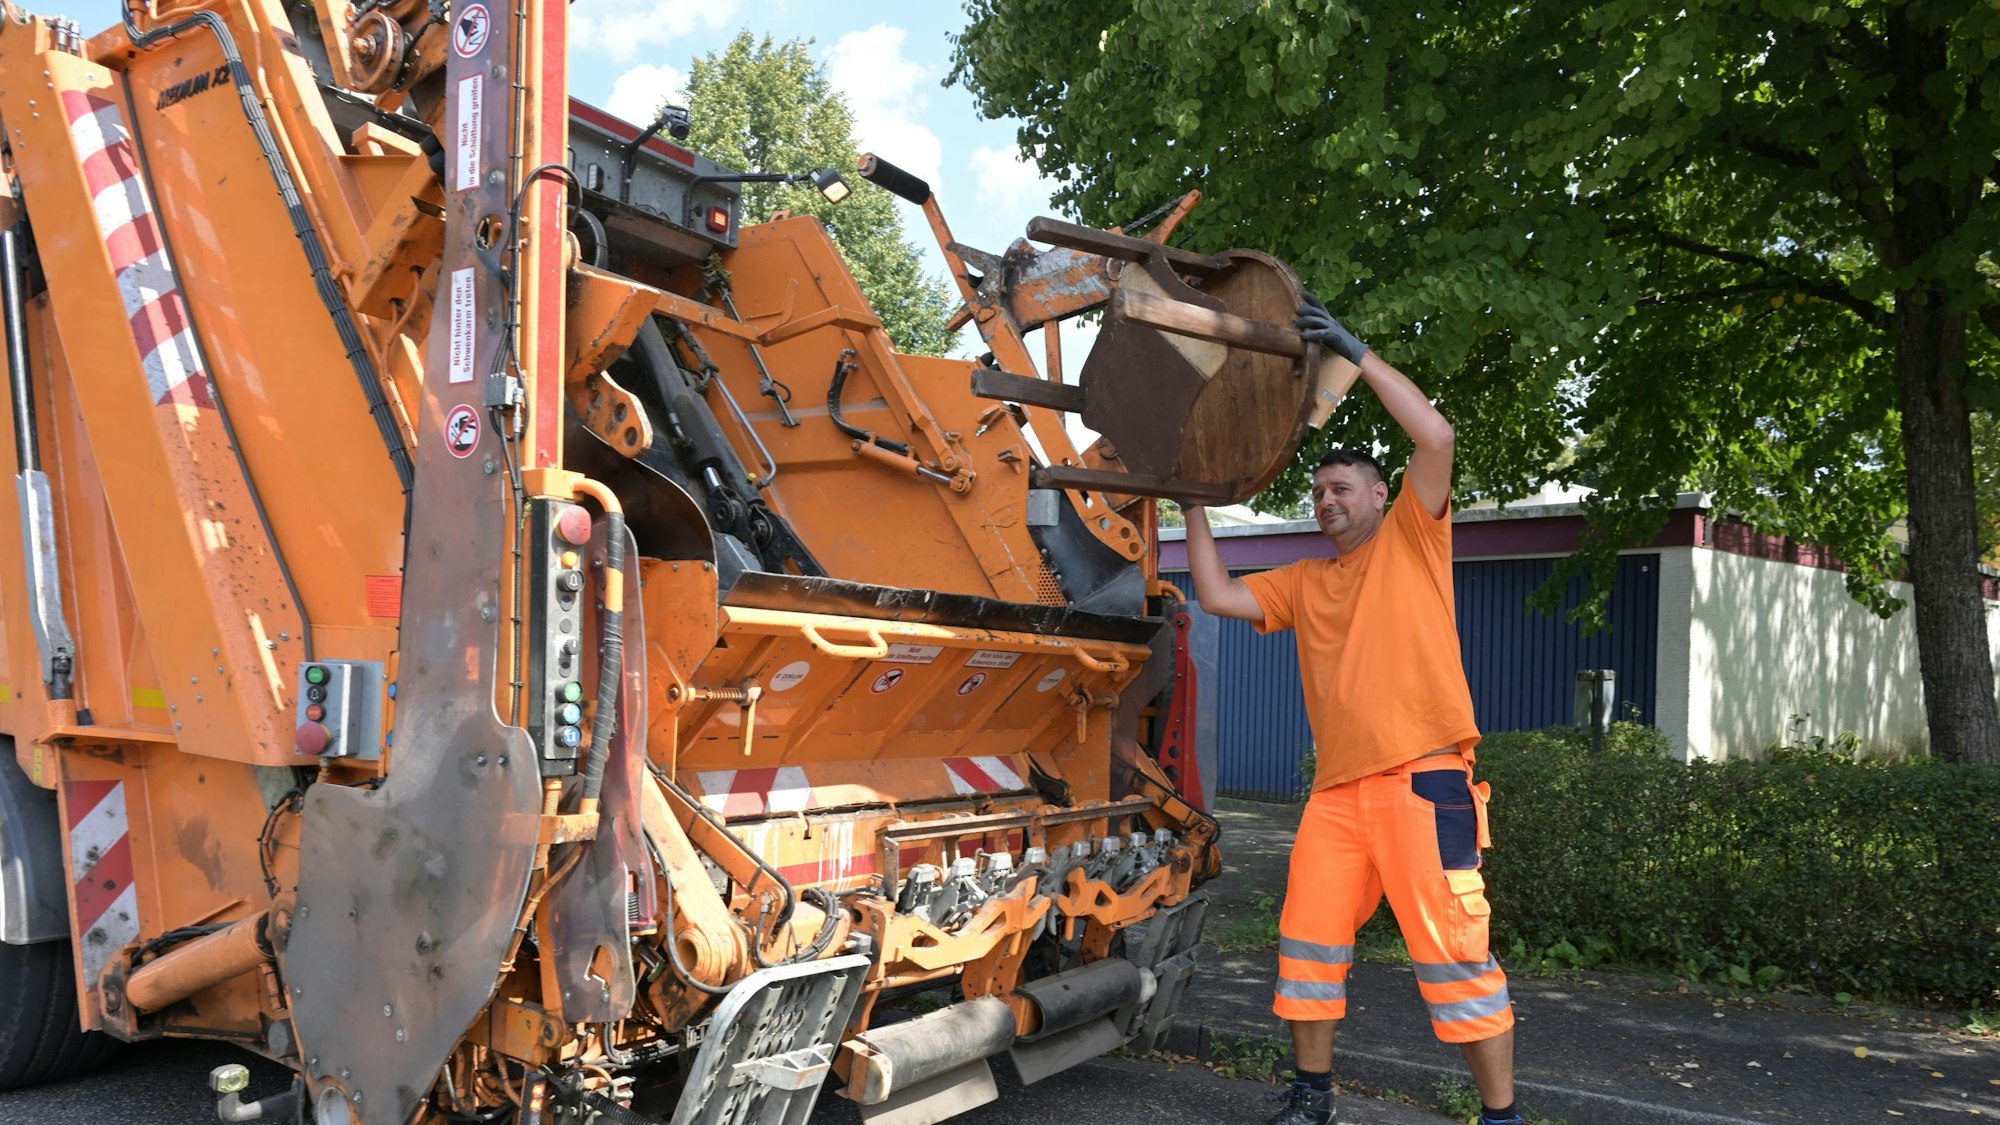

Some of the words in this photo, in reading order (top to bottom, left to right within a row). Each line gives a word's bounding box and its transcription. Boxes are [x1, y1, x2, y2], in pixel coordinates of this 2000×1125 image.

[156, 71, 210, 111] MEDIUM
[469, 112, 479, 158] Schüttung
[468, 176, 475, 186] in
[454, 286, 462, 305] den
[454, 308, 462, 338] hinter
[453, 340, 461, 366] Nicht
[463, 310, 472, 373] Schwenkarm
